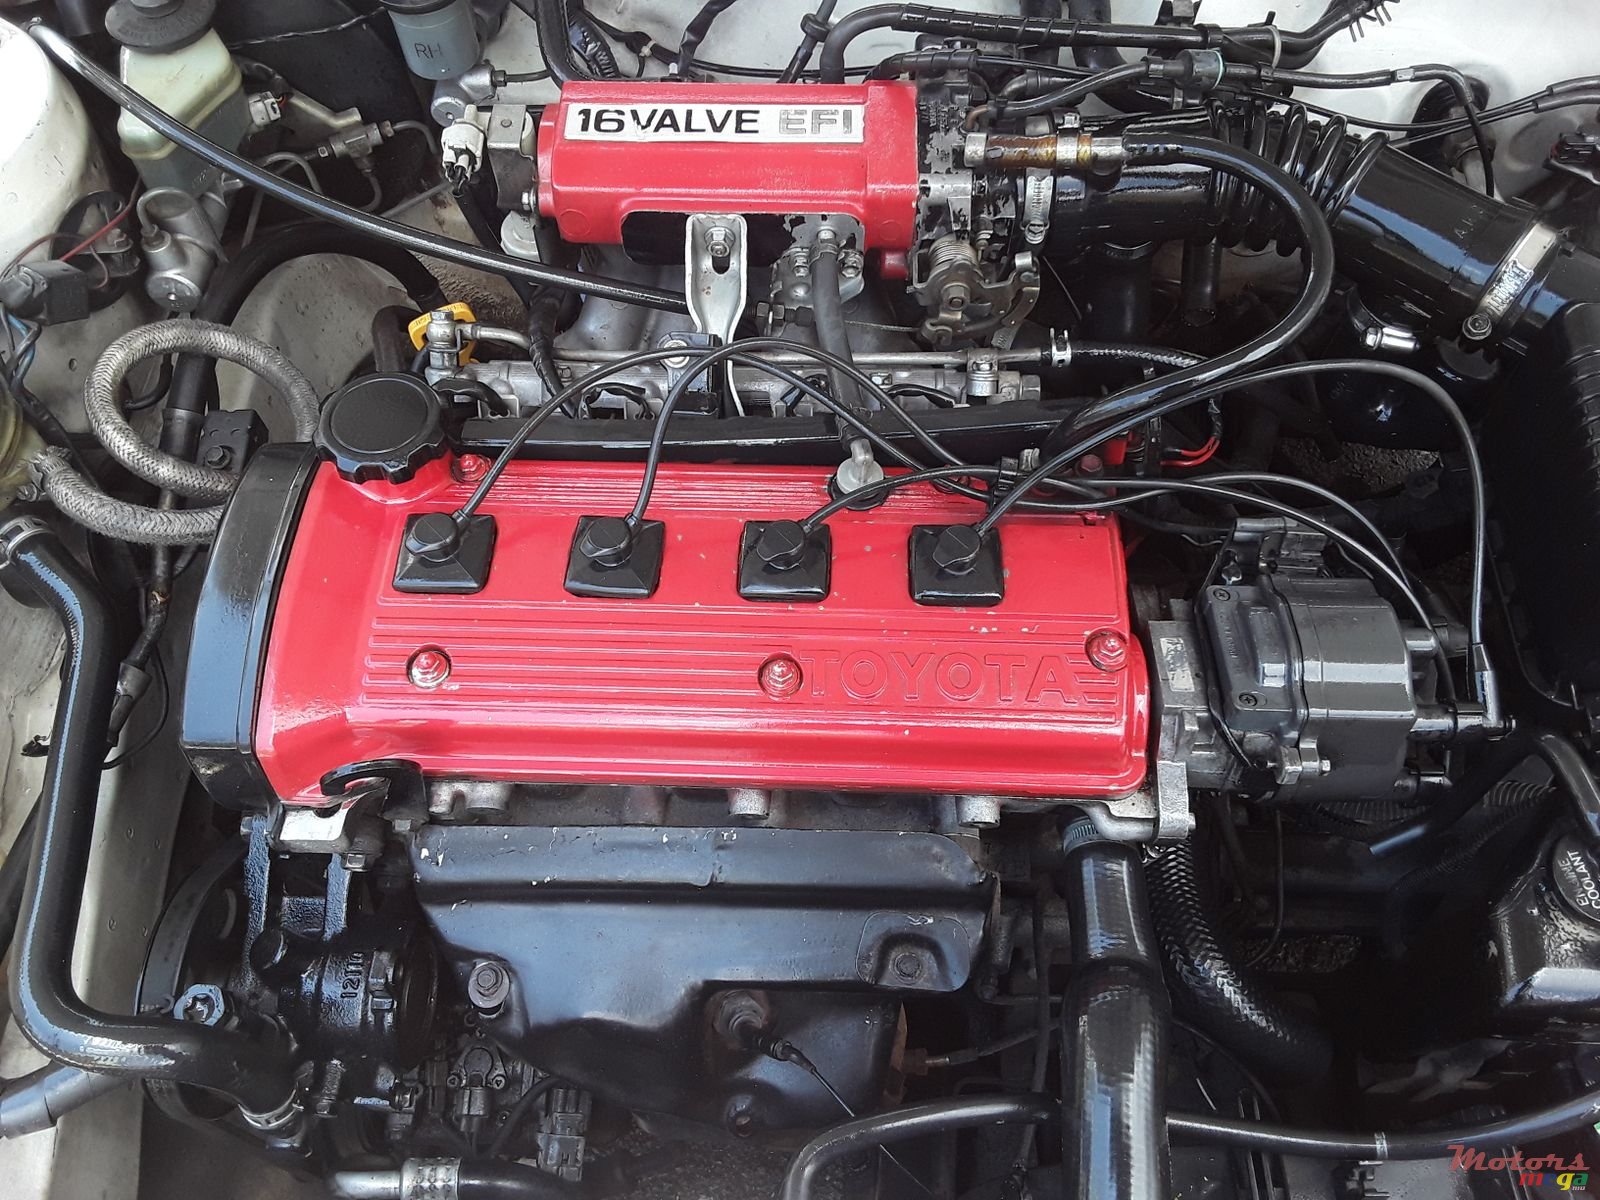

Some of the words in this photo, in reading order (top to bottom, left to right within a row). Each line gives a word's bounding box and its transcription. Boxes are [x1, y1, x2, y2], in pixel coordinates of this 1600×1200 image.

[778, 108, 853, 135] EFI
[799, 649, 1079, 705] TOYOTA
[1566, 850, 1600, 909] COOLANT
